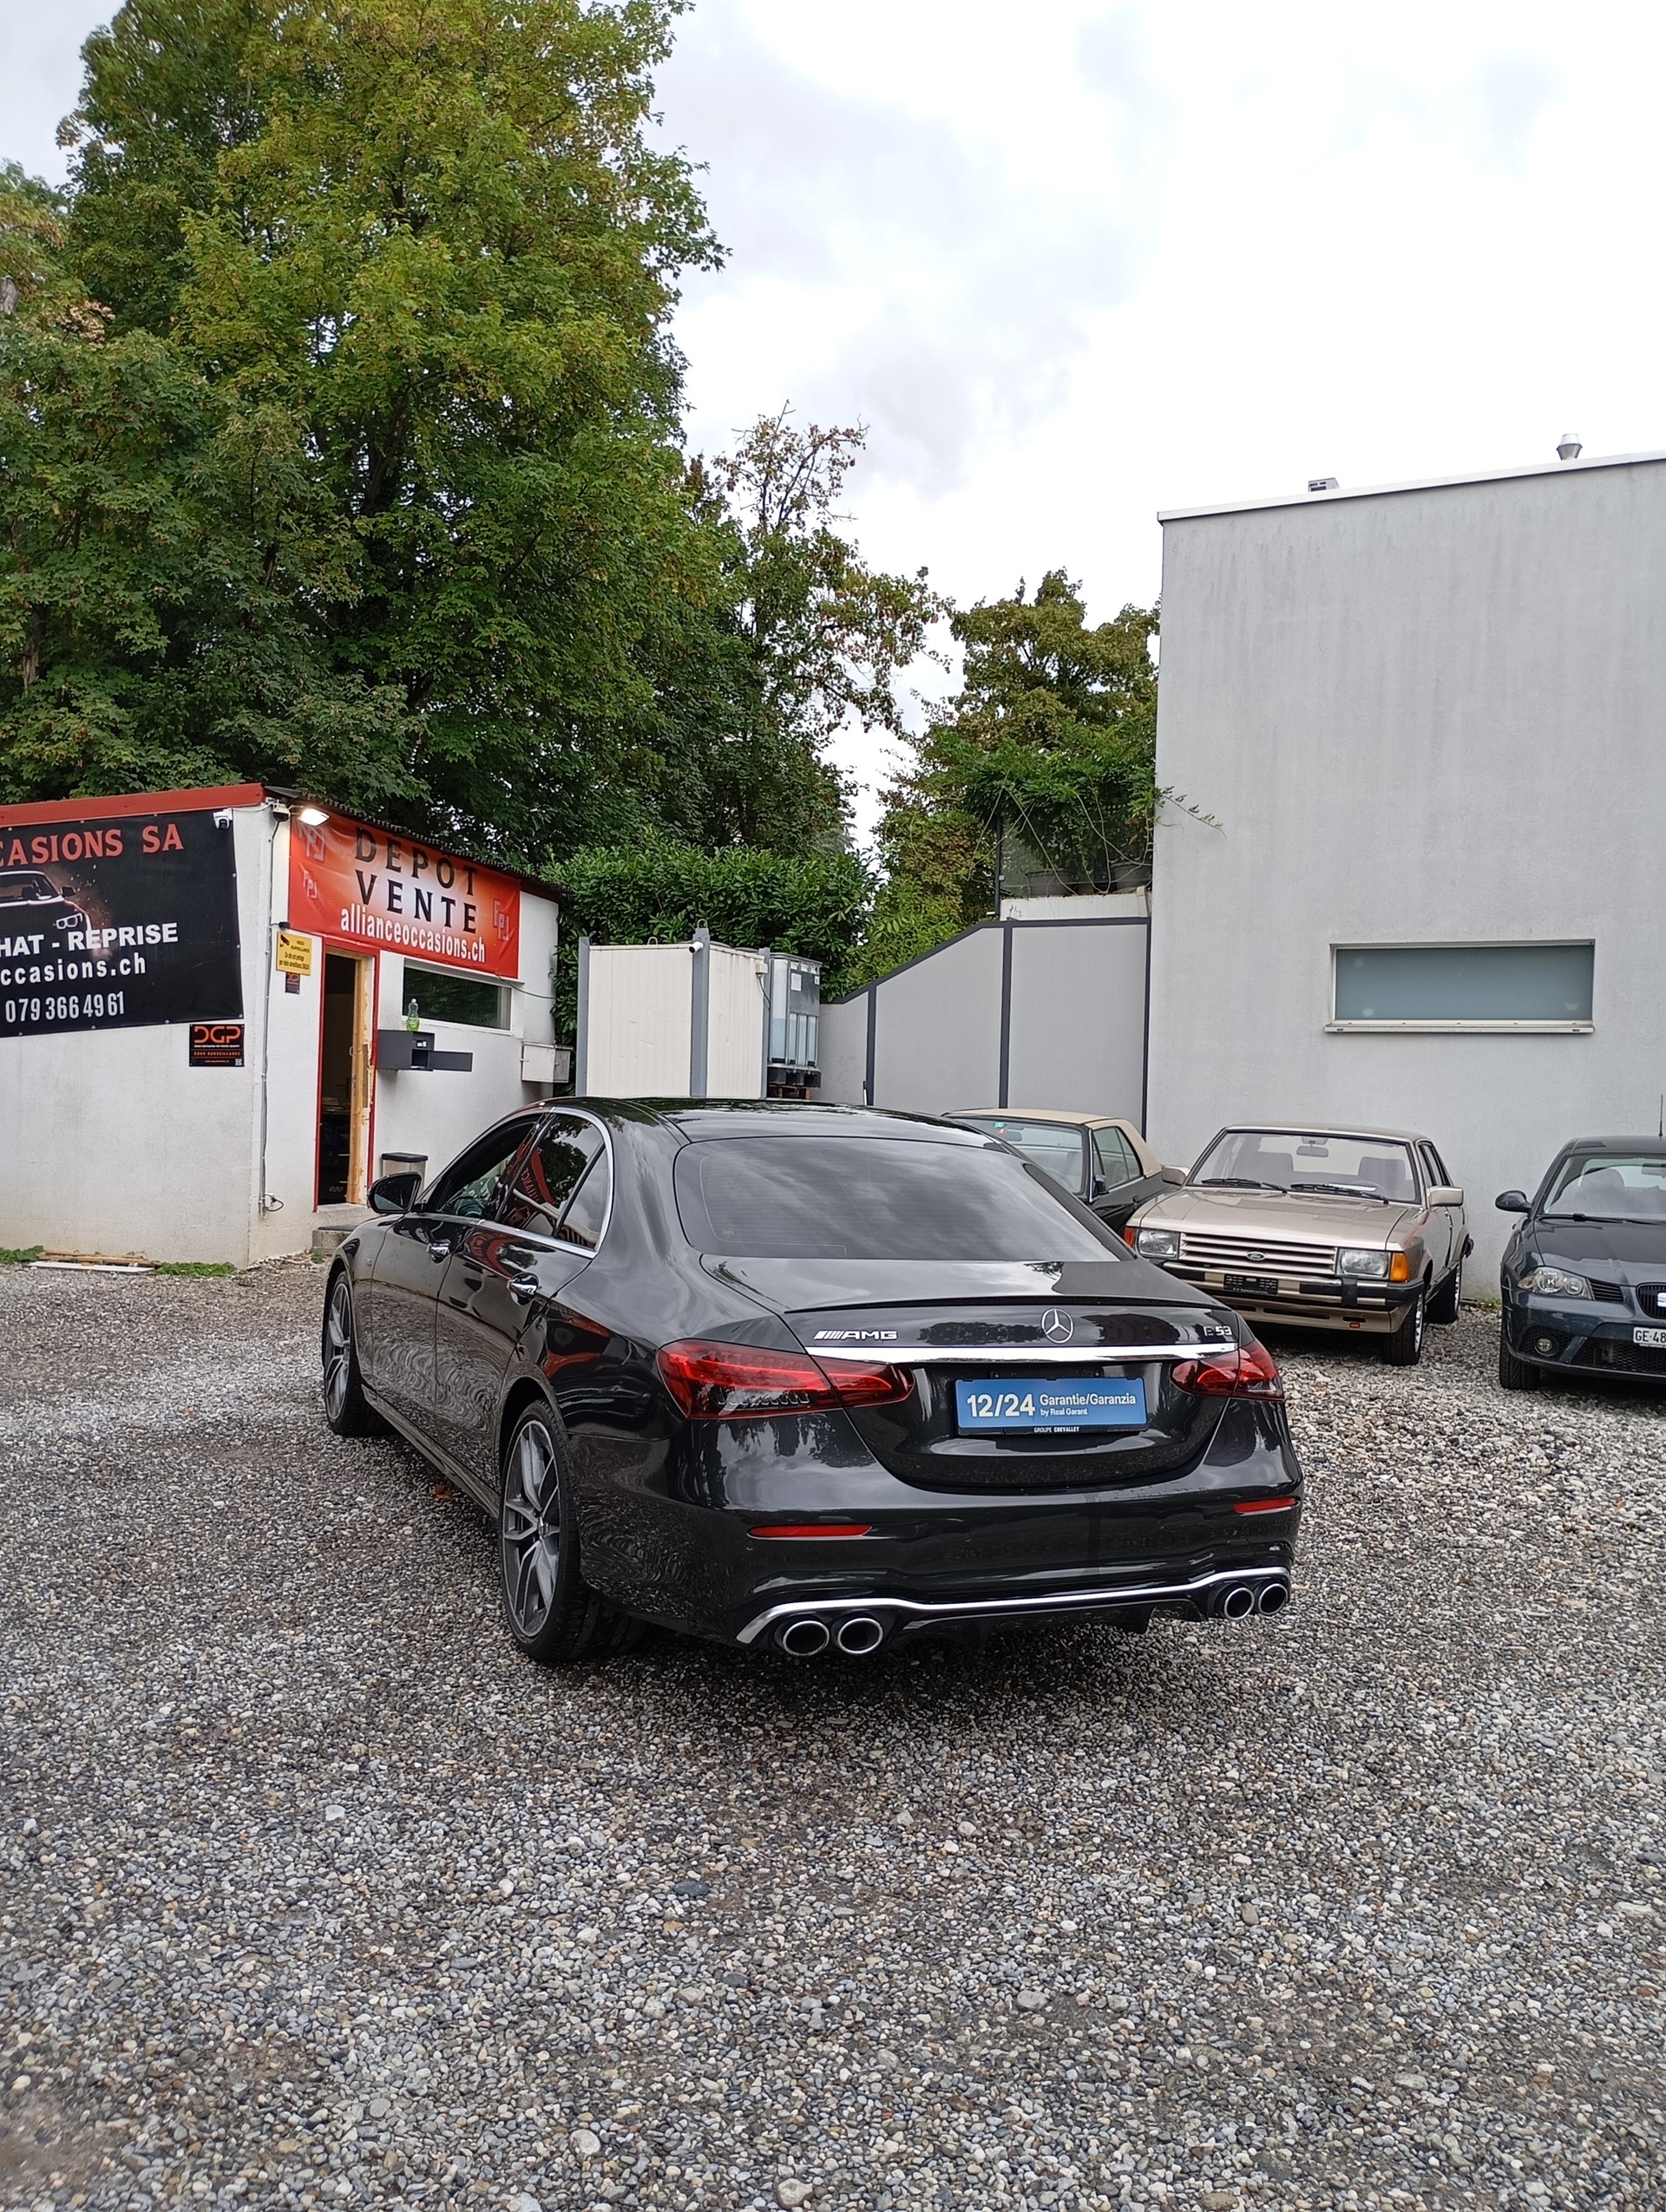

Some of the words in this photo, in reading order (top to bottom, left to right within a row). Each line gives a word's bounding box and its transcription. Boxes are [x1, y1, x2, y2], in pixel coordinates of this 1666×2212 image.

[0, 828, 123, 867] ASIONS
[141, 824, 184, 854] SA
[356, 869, 477, 934] VENTE
[68, 922, 179, 952] REPRISE
[340, 903, 485, 963] allianceoccasions.ch
[5, 998, 41, 1023] 079
[45, 995, 80, 1020] 366
[83, 994, 104, 1018] 49
[108, 991, 125, 1015] 61
[194, 1026, 240, 1044] DGP
[840, 1331, 897, 1340] AMG
[1215, 1326, 1232, 1336] 53
[967, 1393, 1035, 1417] 12/24
[1040, 1392, 1136, 1405] Garantie/Garanzia
[1040, 1409, 1049, 1417] by
[1066, 1407, 1088, 1416] Garant
